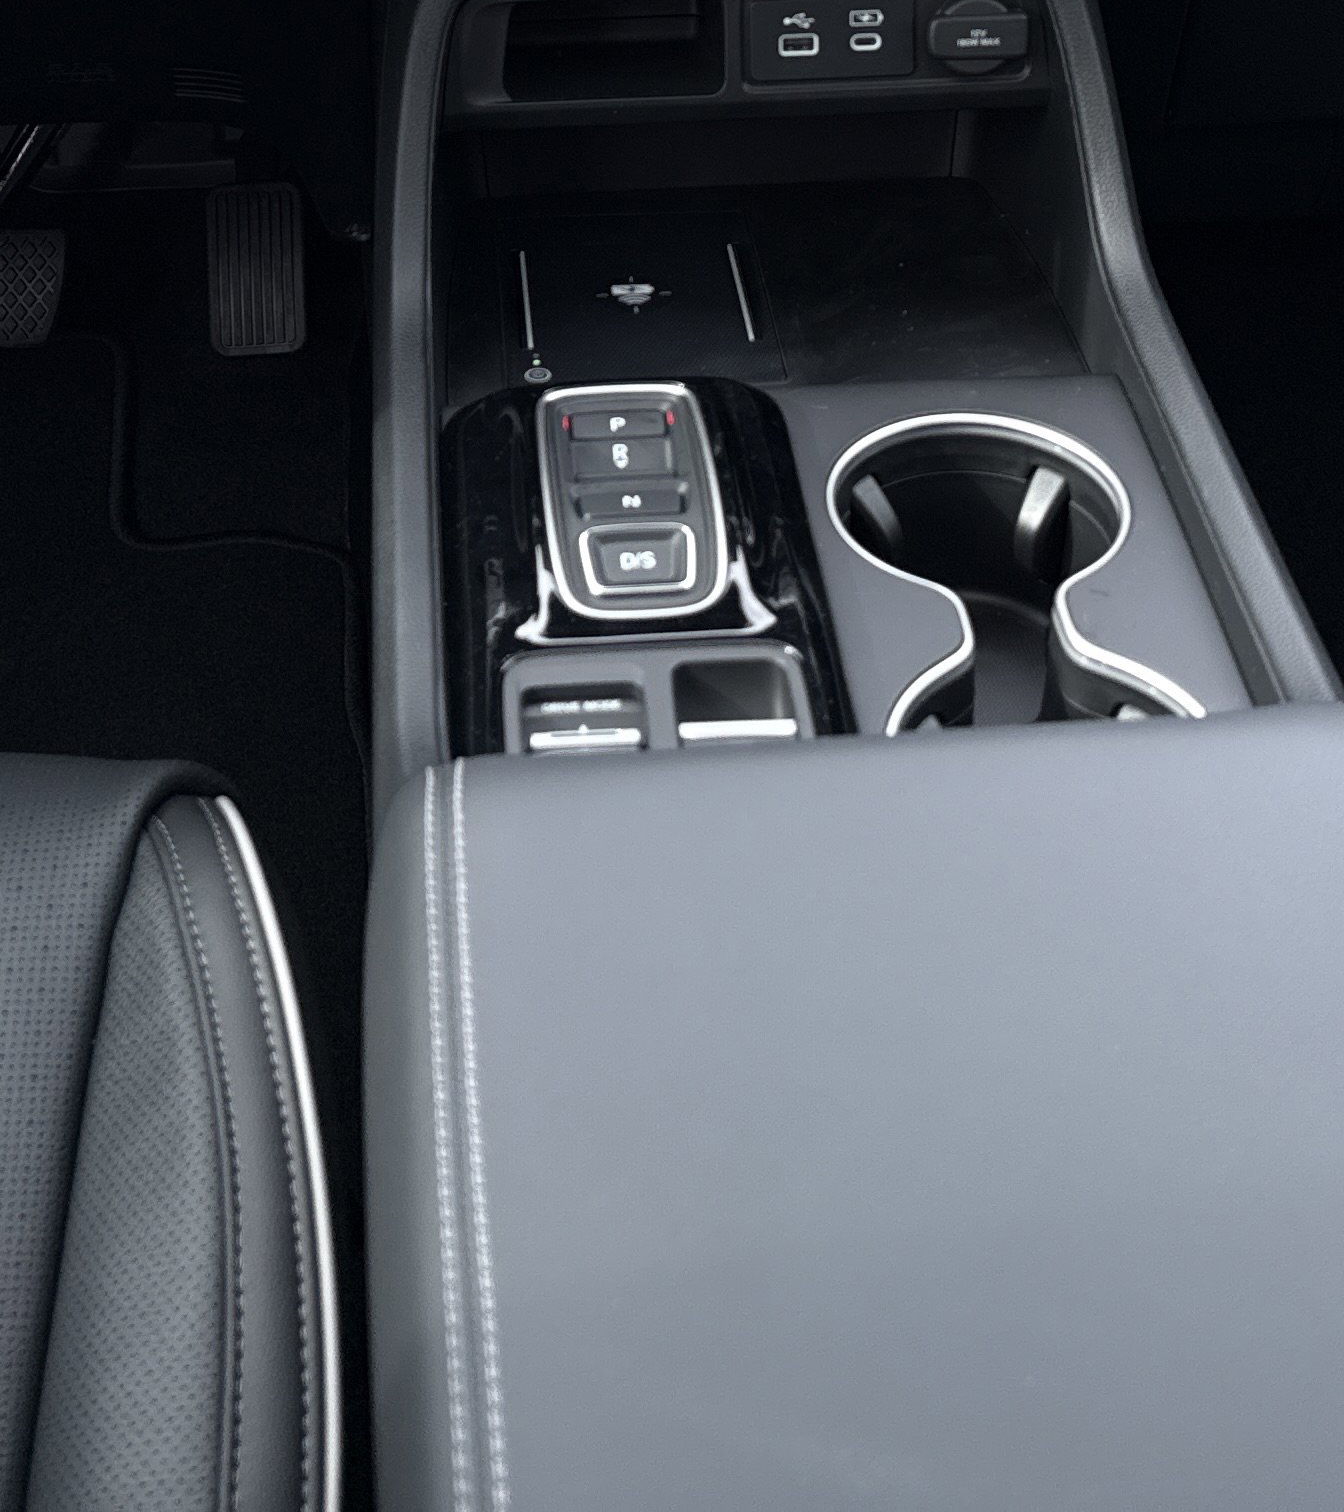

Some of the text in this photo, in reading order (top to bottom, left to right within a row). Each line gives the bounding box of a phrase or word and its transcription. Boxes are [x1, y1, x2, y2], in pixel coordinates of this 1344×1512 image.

[609, 416, 627, 433] P
[611, 443, 629, 458] R
[621, 494, 642, 509] N
[619, 550, 657, 570] D/S
